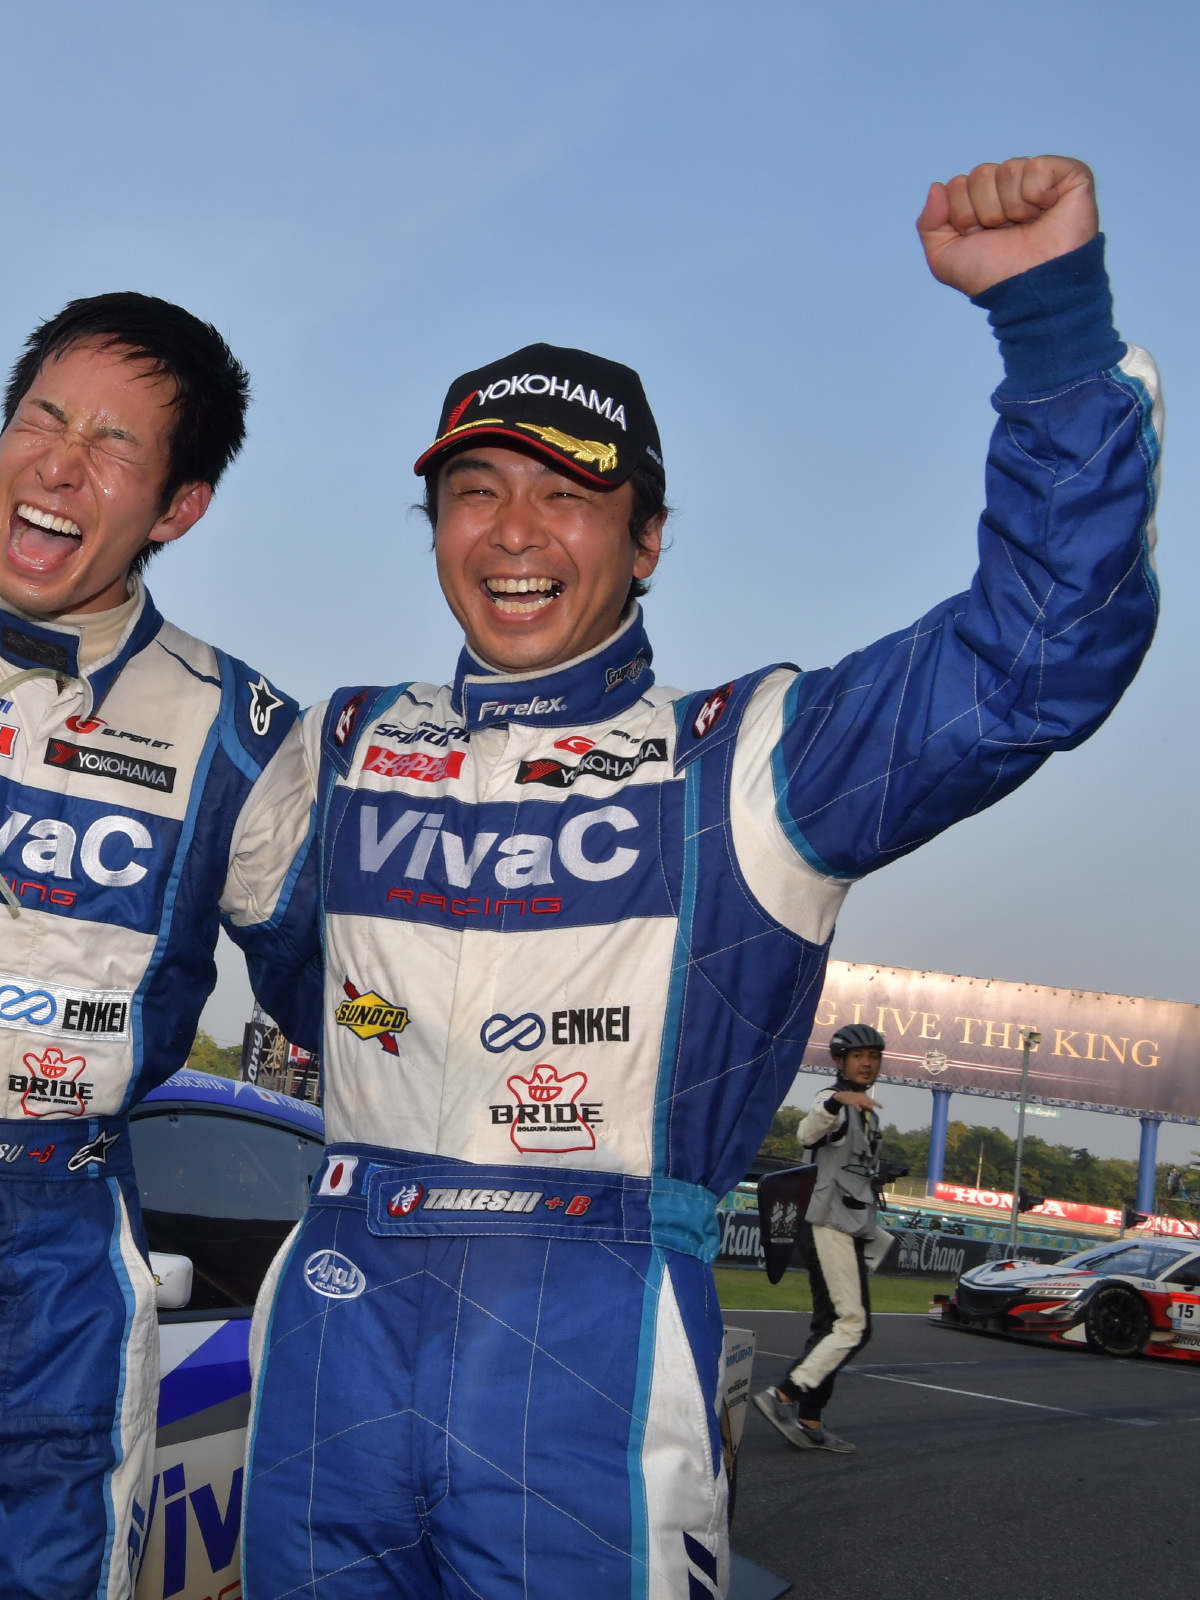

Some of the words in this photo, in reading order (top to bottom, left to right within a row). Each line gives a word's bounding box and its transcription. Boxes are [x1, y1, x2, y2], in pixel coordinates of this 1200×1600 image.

[476, 373, 627, 431] YOKOHAMA
[101, 728, 152, 745] SUPER
[151, 740, 175, 750] GT
[78, 751, 167, 787] YOKOHAMA
[358, 804, 641, 890] VivaC
[386, 888, 563, 916] RACING
[61, 999, 127, 1033] ENKEI
[338, 1003, 407, 1030] SUNOCO
[551, 1005, 631, 1045] ENKEI
[851, 1003, 942, 1040] LIVE
[954, 1016, 1042, 1054] THE
[1051, 1028, 1161, 1068] KING
[8, 1074, 94, 1100] BRIDE
[488, 1103, 604, 1124] BRIDE
[392, 1184, 419, 1213] 侍
[421, 1187, 544, 1214] TAKESHI
[954, 1187, 1066, 1218] HONA
[919, 1233, 966, 1277] Chang
[307, 1253, 358, 1290] Arai
[1177, 1304, 1195, 1319] 15
